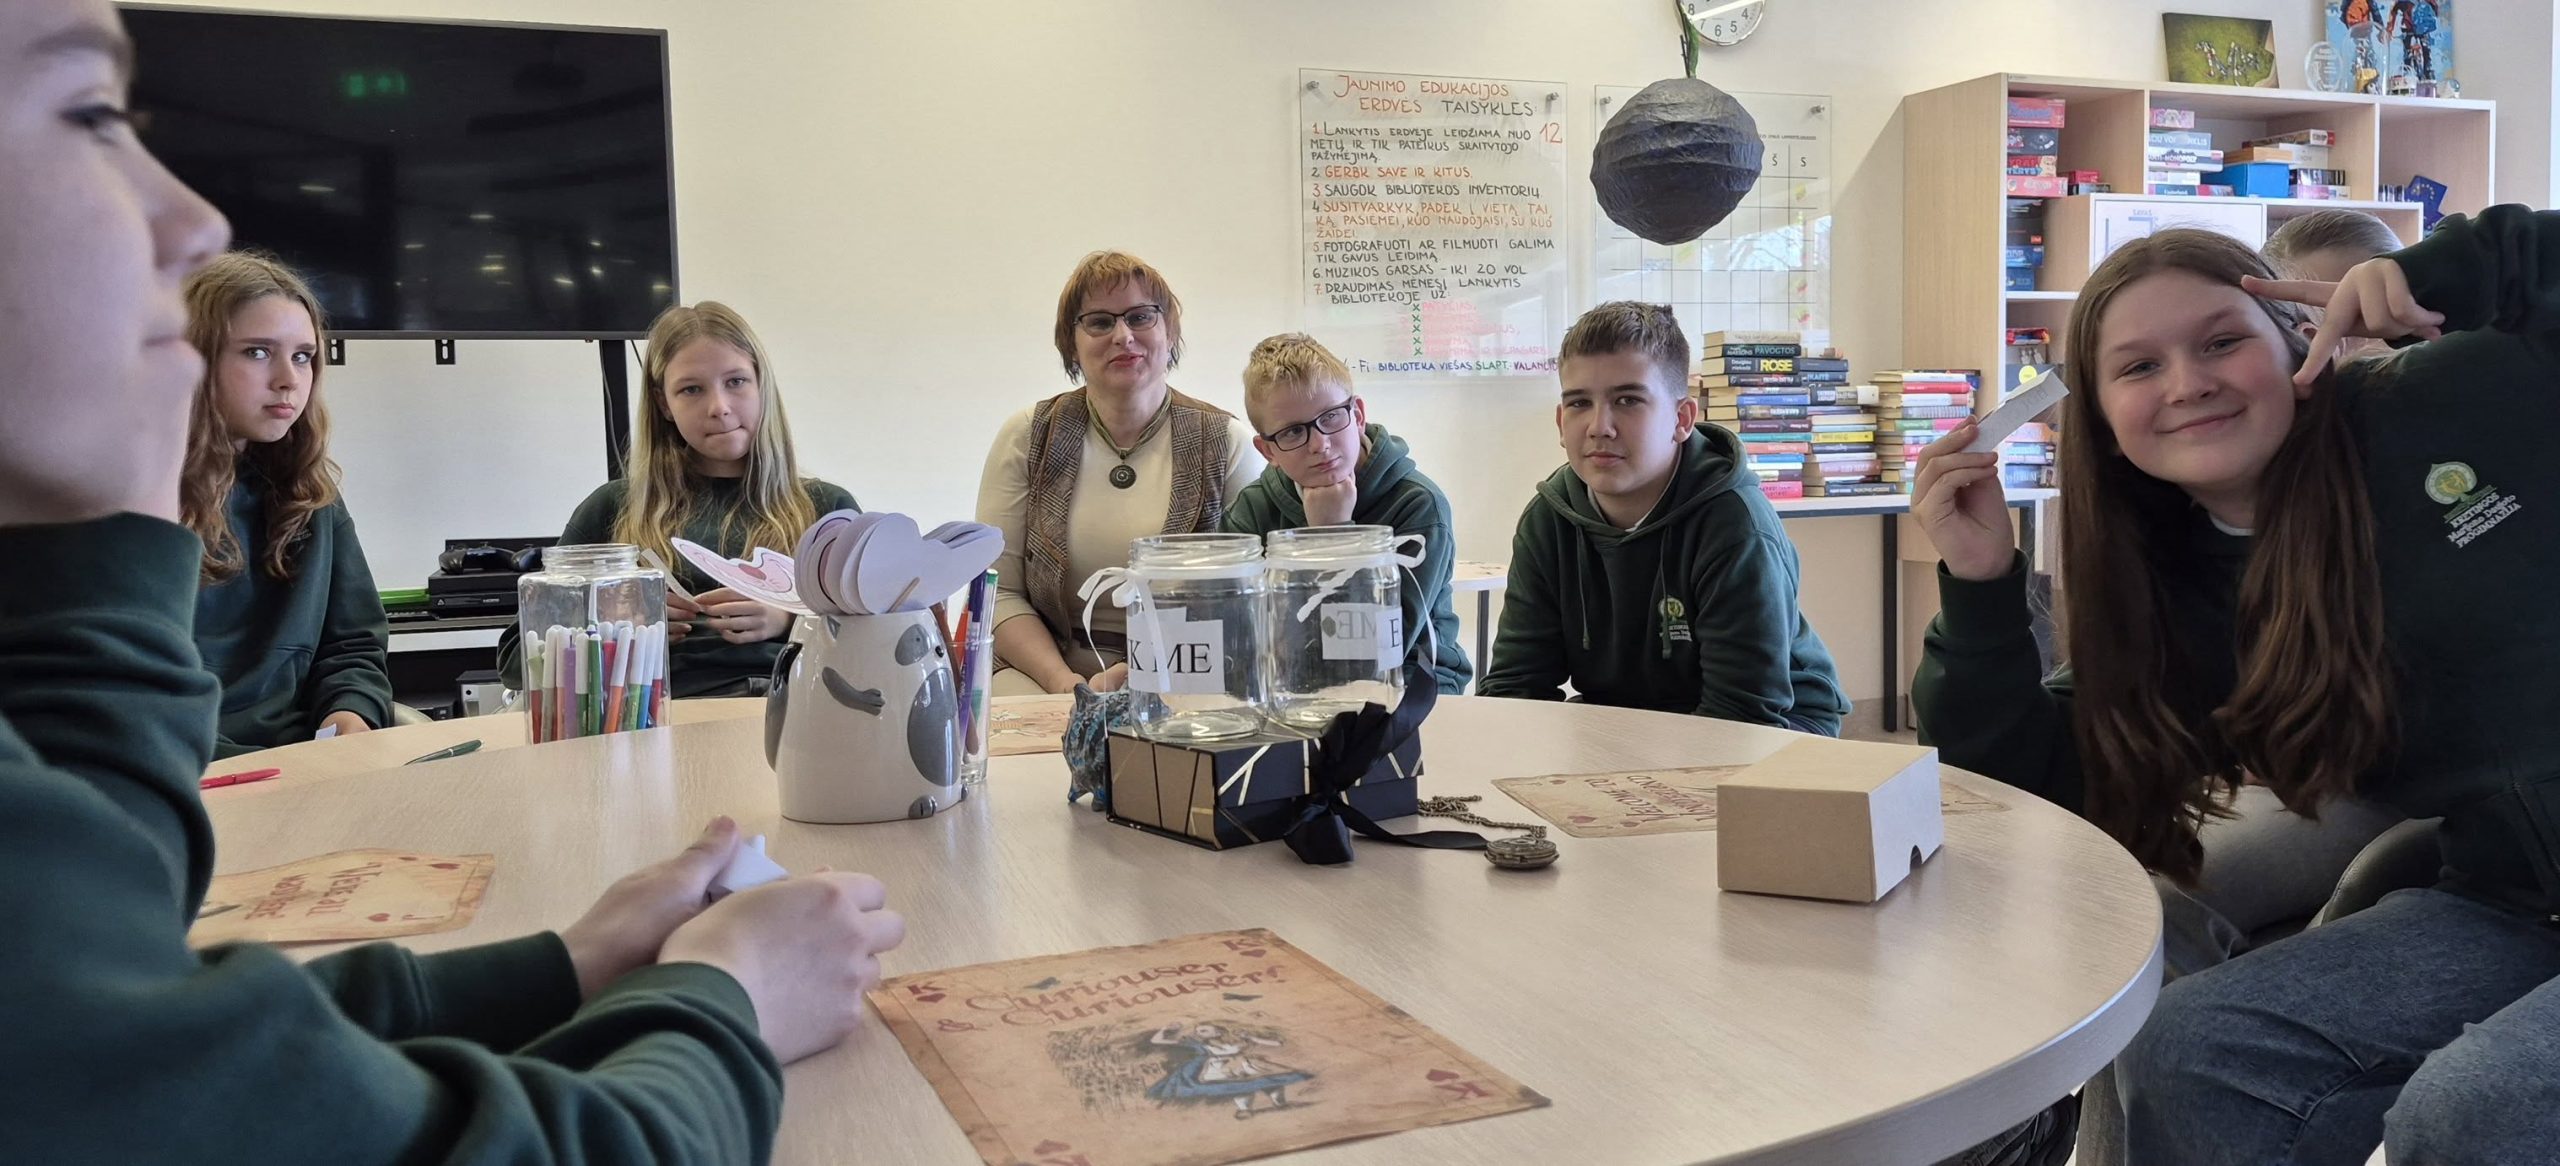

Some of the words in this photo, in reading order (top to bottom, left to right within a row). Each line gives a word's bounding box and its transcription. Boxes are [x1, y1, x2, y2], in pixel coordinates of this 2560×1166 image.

[1741, 8, 1749, 19] 4
[1714, 25, 1721, 37] 6
[1730, 21, 1738, 33] 5
[1420, 80, 1509, 101] EDUKACIJOS
[1508, 130, 1531, 141] NUO
[1539, 122, 1563, 144] 12
[1352, 139, 1366, 150] IR
[1370, 138, 1391, 151] TIK
[1398, 140, 1450, 152] PATEIKUS
[1458, 141, 1519, 154] SKAITYTOJO
[1800, 156, 1807, 167] S
[1324, 165, 1370, 179] GERBK
[1377, 166, 1408, 178] SAVE
[1414, 166, 1426, 178] IR
[1325, 184, 1377, 197] SAUGOK
[1385, 184, 1460, 196] BIBLIOTEKOS
[1511, 217, 1525, 227] SU
[1324, 239, 1411, 252] FOTOGRAFUOTI
[1418, 239, 1436, 250] AR
[1443, 238, 1498, 249] FILMUOTI
[1508, 239, 1555, 249] GALIMA
[1316, 253, 1337, 263] TIK
[1342, 252, 1379, 263] GAVUS
[1325, 266, 1380, 278] MUZIKOS
[1385, 264, 1434, 276] GARSAS
[1451, 264, 1467, 275] IKI
[1477, 263, 1496, 275] 20
[1325, 280, 1394, 294] DRAUDIMAS
[1459, 278, 1521, 288] LANKYTIS
[1331, 290, 1420, 306] BIBLIOTEKOJE
[1378, 361, 1435, 371] BIBLIOTEKA
[1760, 358, 1793, 372] ROSE
[965, 960, 1230, 1012] Curiouser
